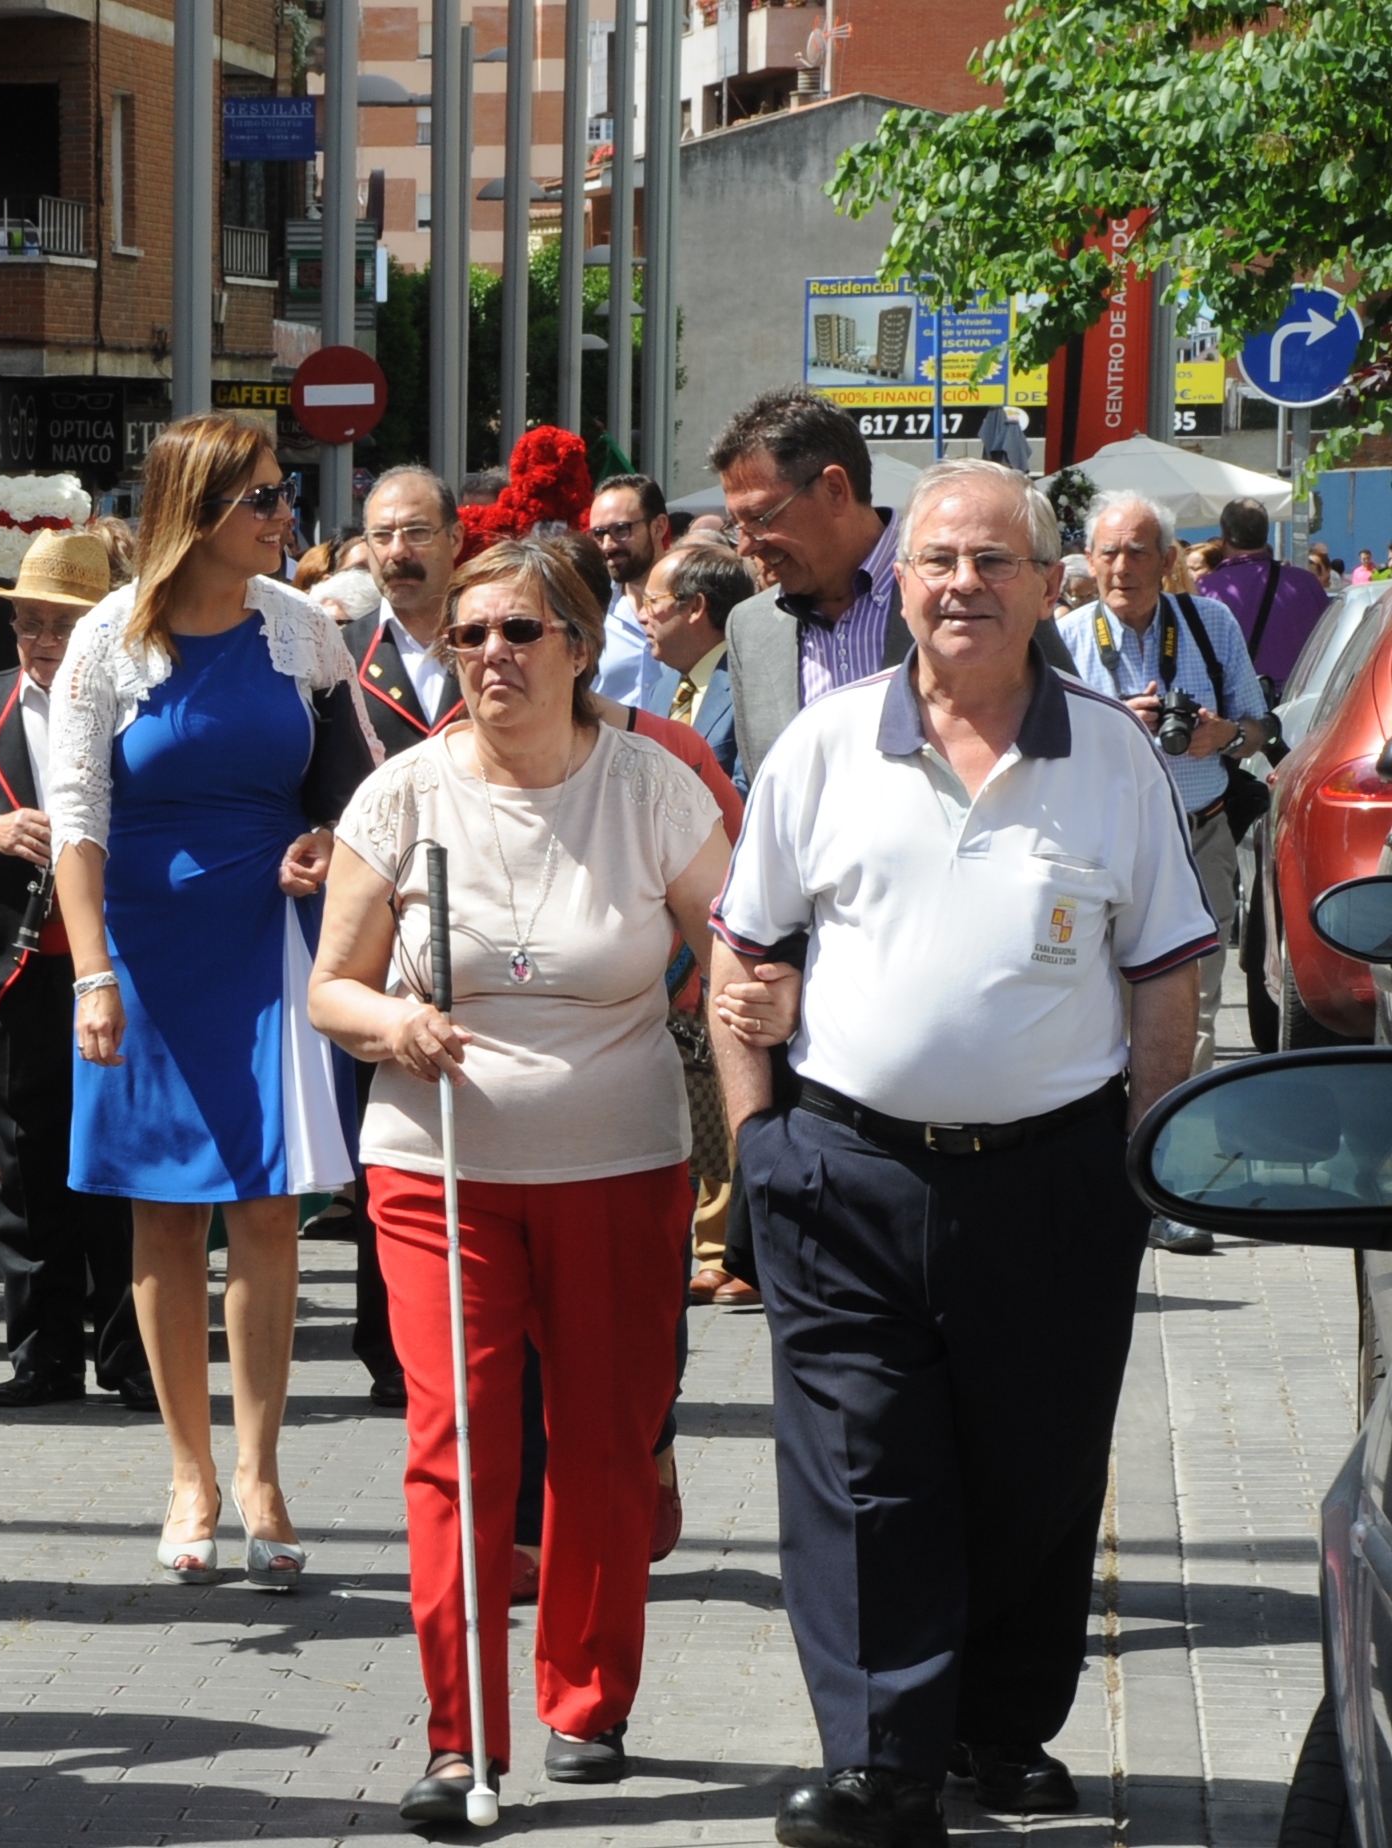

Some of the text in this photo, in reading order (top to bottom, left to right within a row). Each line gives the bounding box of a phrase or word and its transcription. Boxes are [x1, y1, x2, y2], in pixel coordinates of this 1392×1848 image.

[223, 101, 313, 116] GESVILAR
[231, 118, 303, 128] Inmobiliaria
[809, 280, 899, 296] Residencial
[956, 318, 992, 326] Privada
[1109, 310, 1127, 338] DE
[942, 339, 992, 348] ISCINA
[1105, 343, 1126, 428] CENTRO
[873, 387, 981, 404] FINANCICIÓN
[48, 419, 115, 440] OPTICA
[859, 414, 899, 436] 617
[905, 414, 931, 435] 17
[51, 444, 112, 464] NAYCO
[1164, 626, 1175, 657] Nikon
